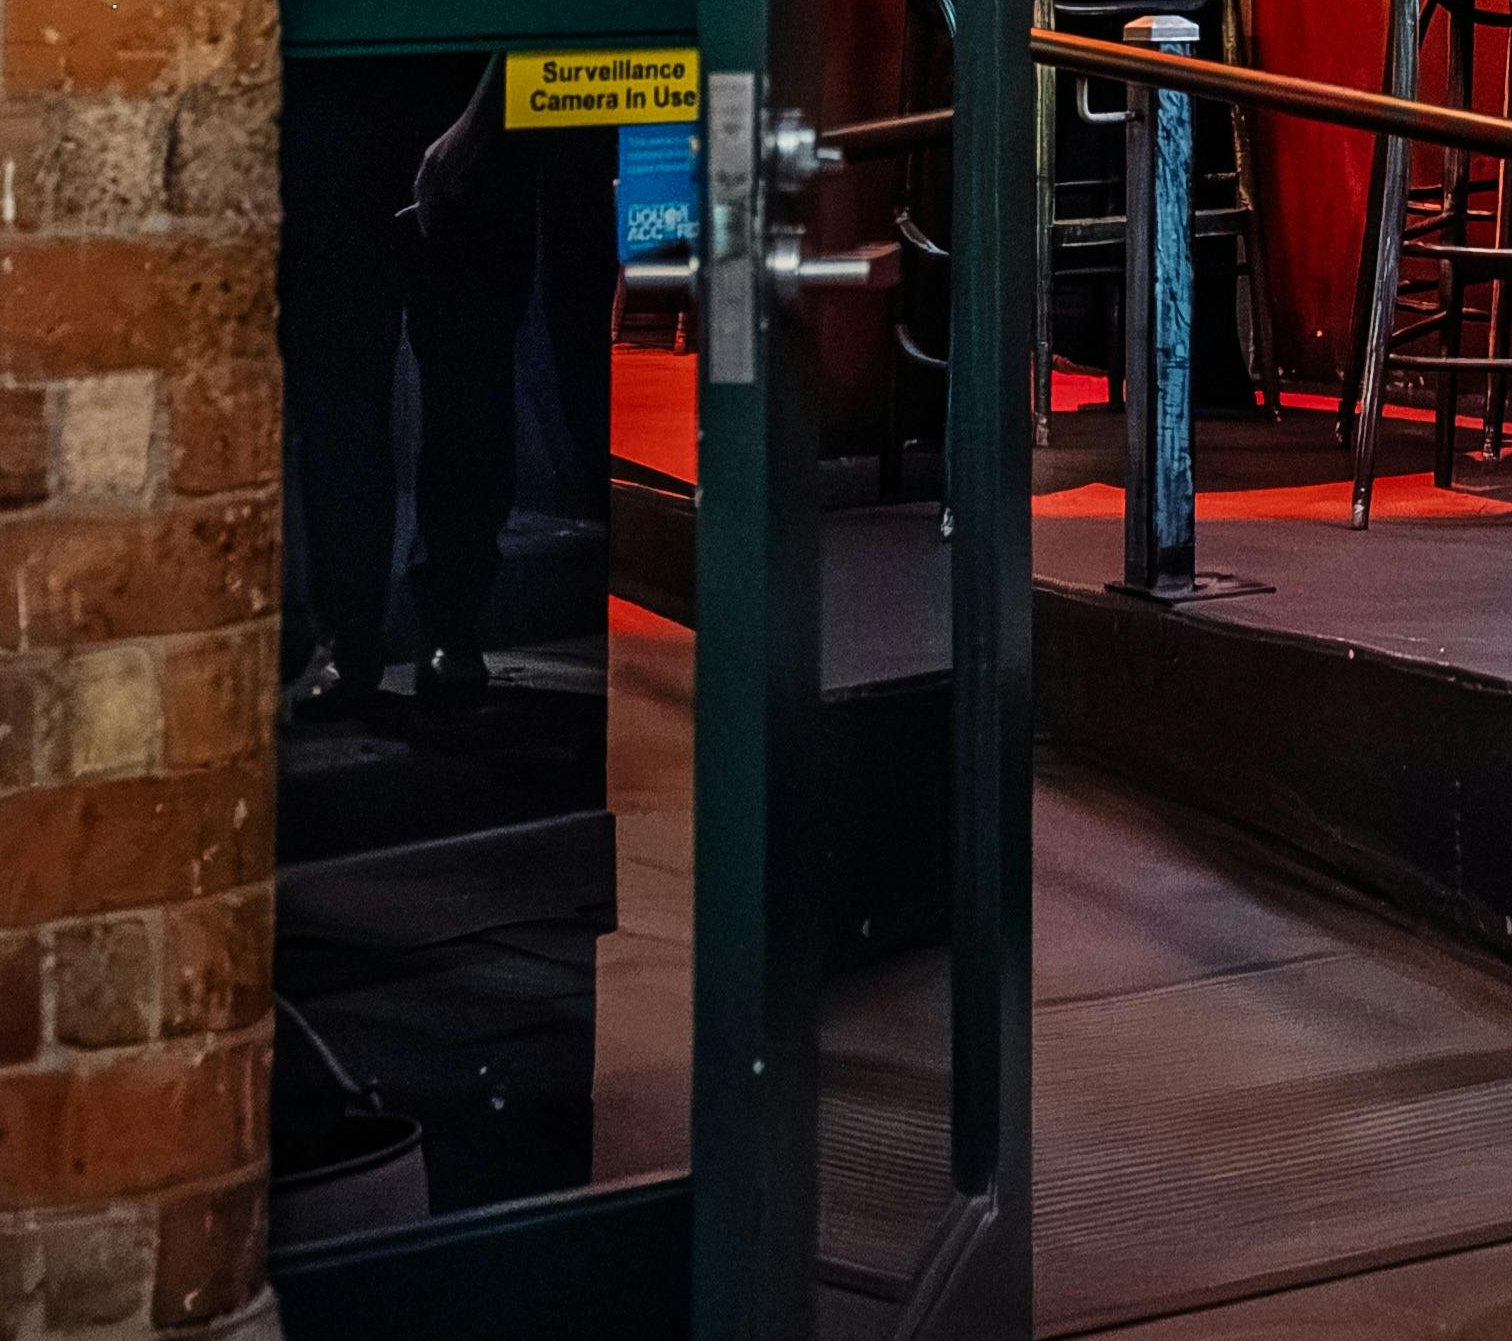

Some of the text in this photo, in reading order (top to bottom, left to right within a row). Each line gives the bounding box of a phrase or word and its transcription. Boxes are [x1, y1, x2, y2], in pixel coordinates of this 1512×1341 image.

[542, 59, 686, 84] Surveillance
[529, 85, 697, 112] Camera In Use
